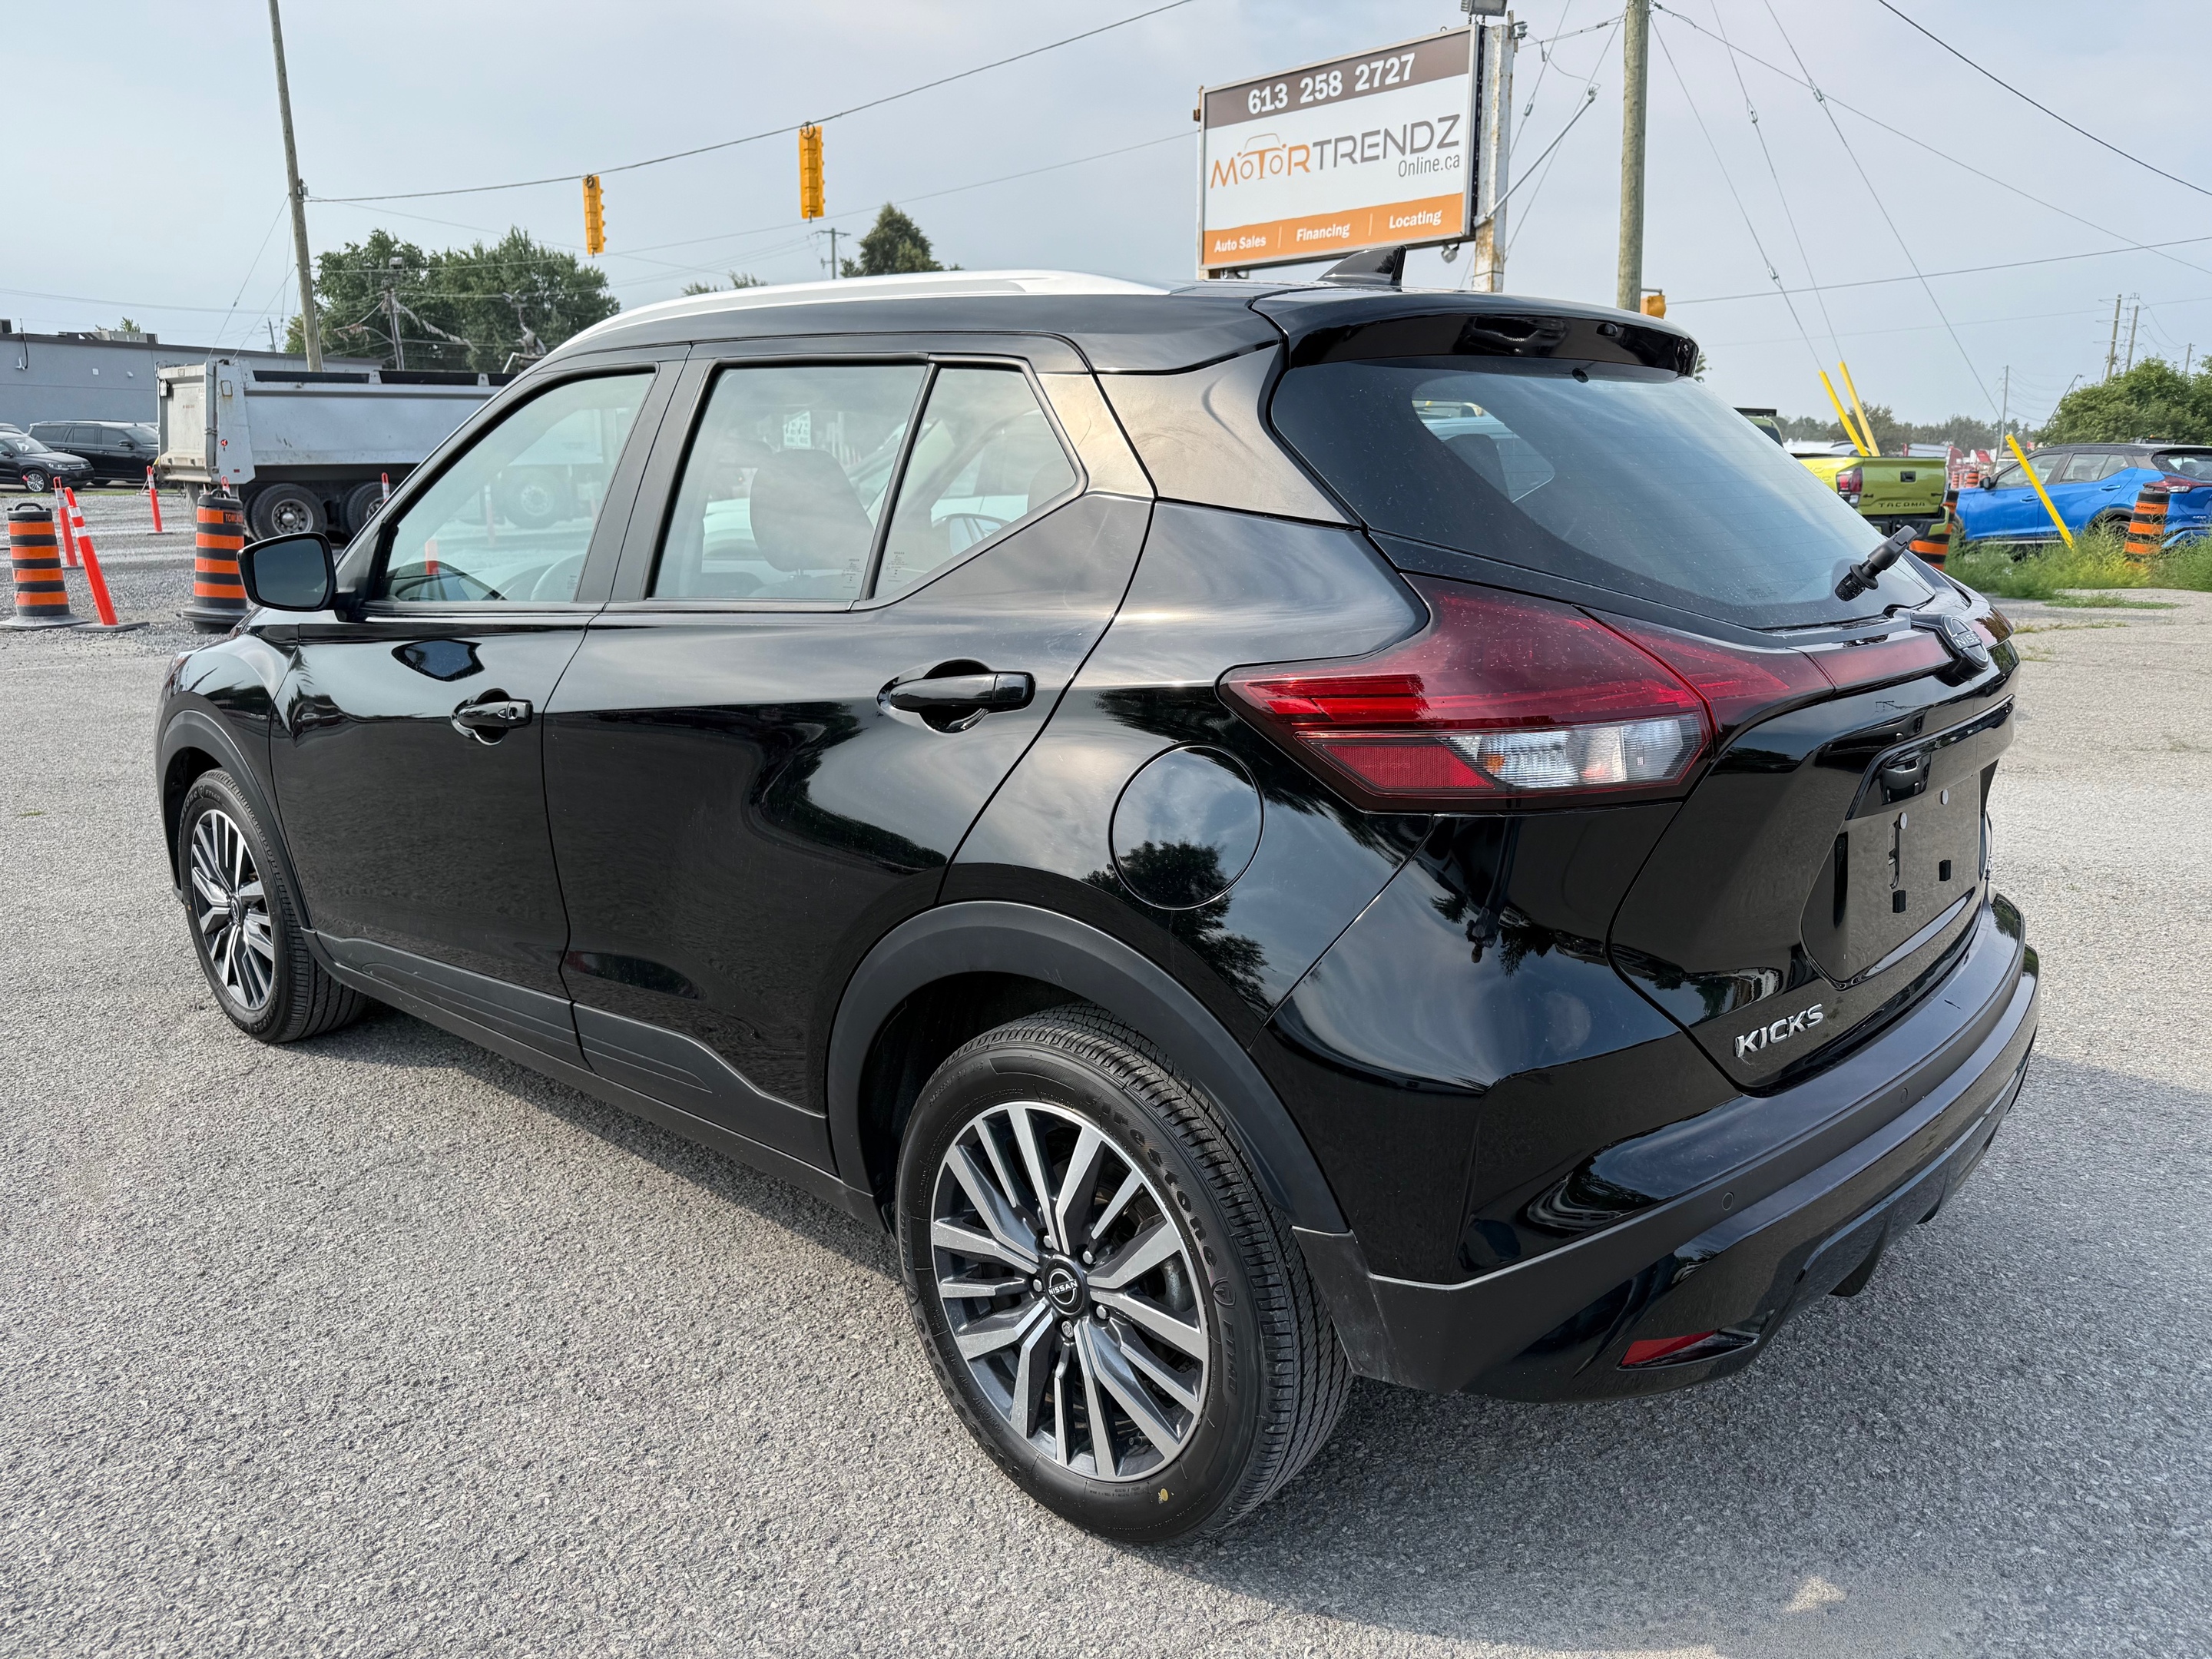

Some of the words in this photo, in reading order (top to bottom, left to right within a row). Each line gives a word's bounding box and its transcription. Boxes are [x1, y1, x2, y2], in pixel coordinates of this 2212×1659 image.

[1247, 83, 1288, 114] 613
[1300, 71, 1343, 104] 258
[1355, 52, 1416, 91] 2727
[1398, 153, 1460, 178] Online.ca
[1389, 209, 1442, 230] Locating
[1296, 223, 1350, 242] Financing
[1214, 238, 1237, 253] Auto
[1238, 235, 1267, 250] Sales
[1955, 633, 1980, 647] NISS
[1734, 1003, 1824, 1058] KICKS
[1048, 1280, 1078, 1296] NISSAN
